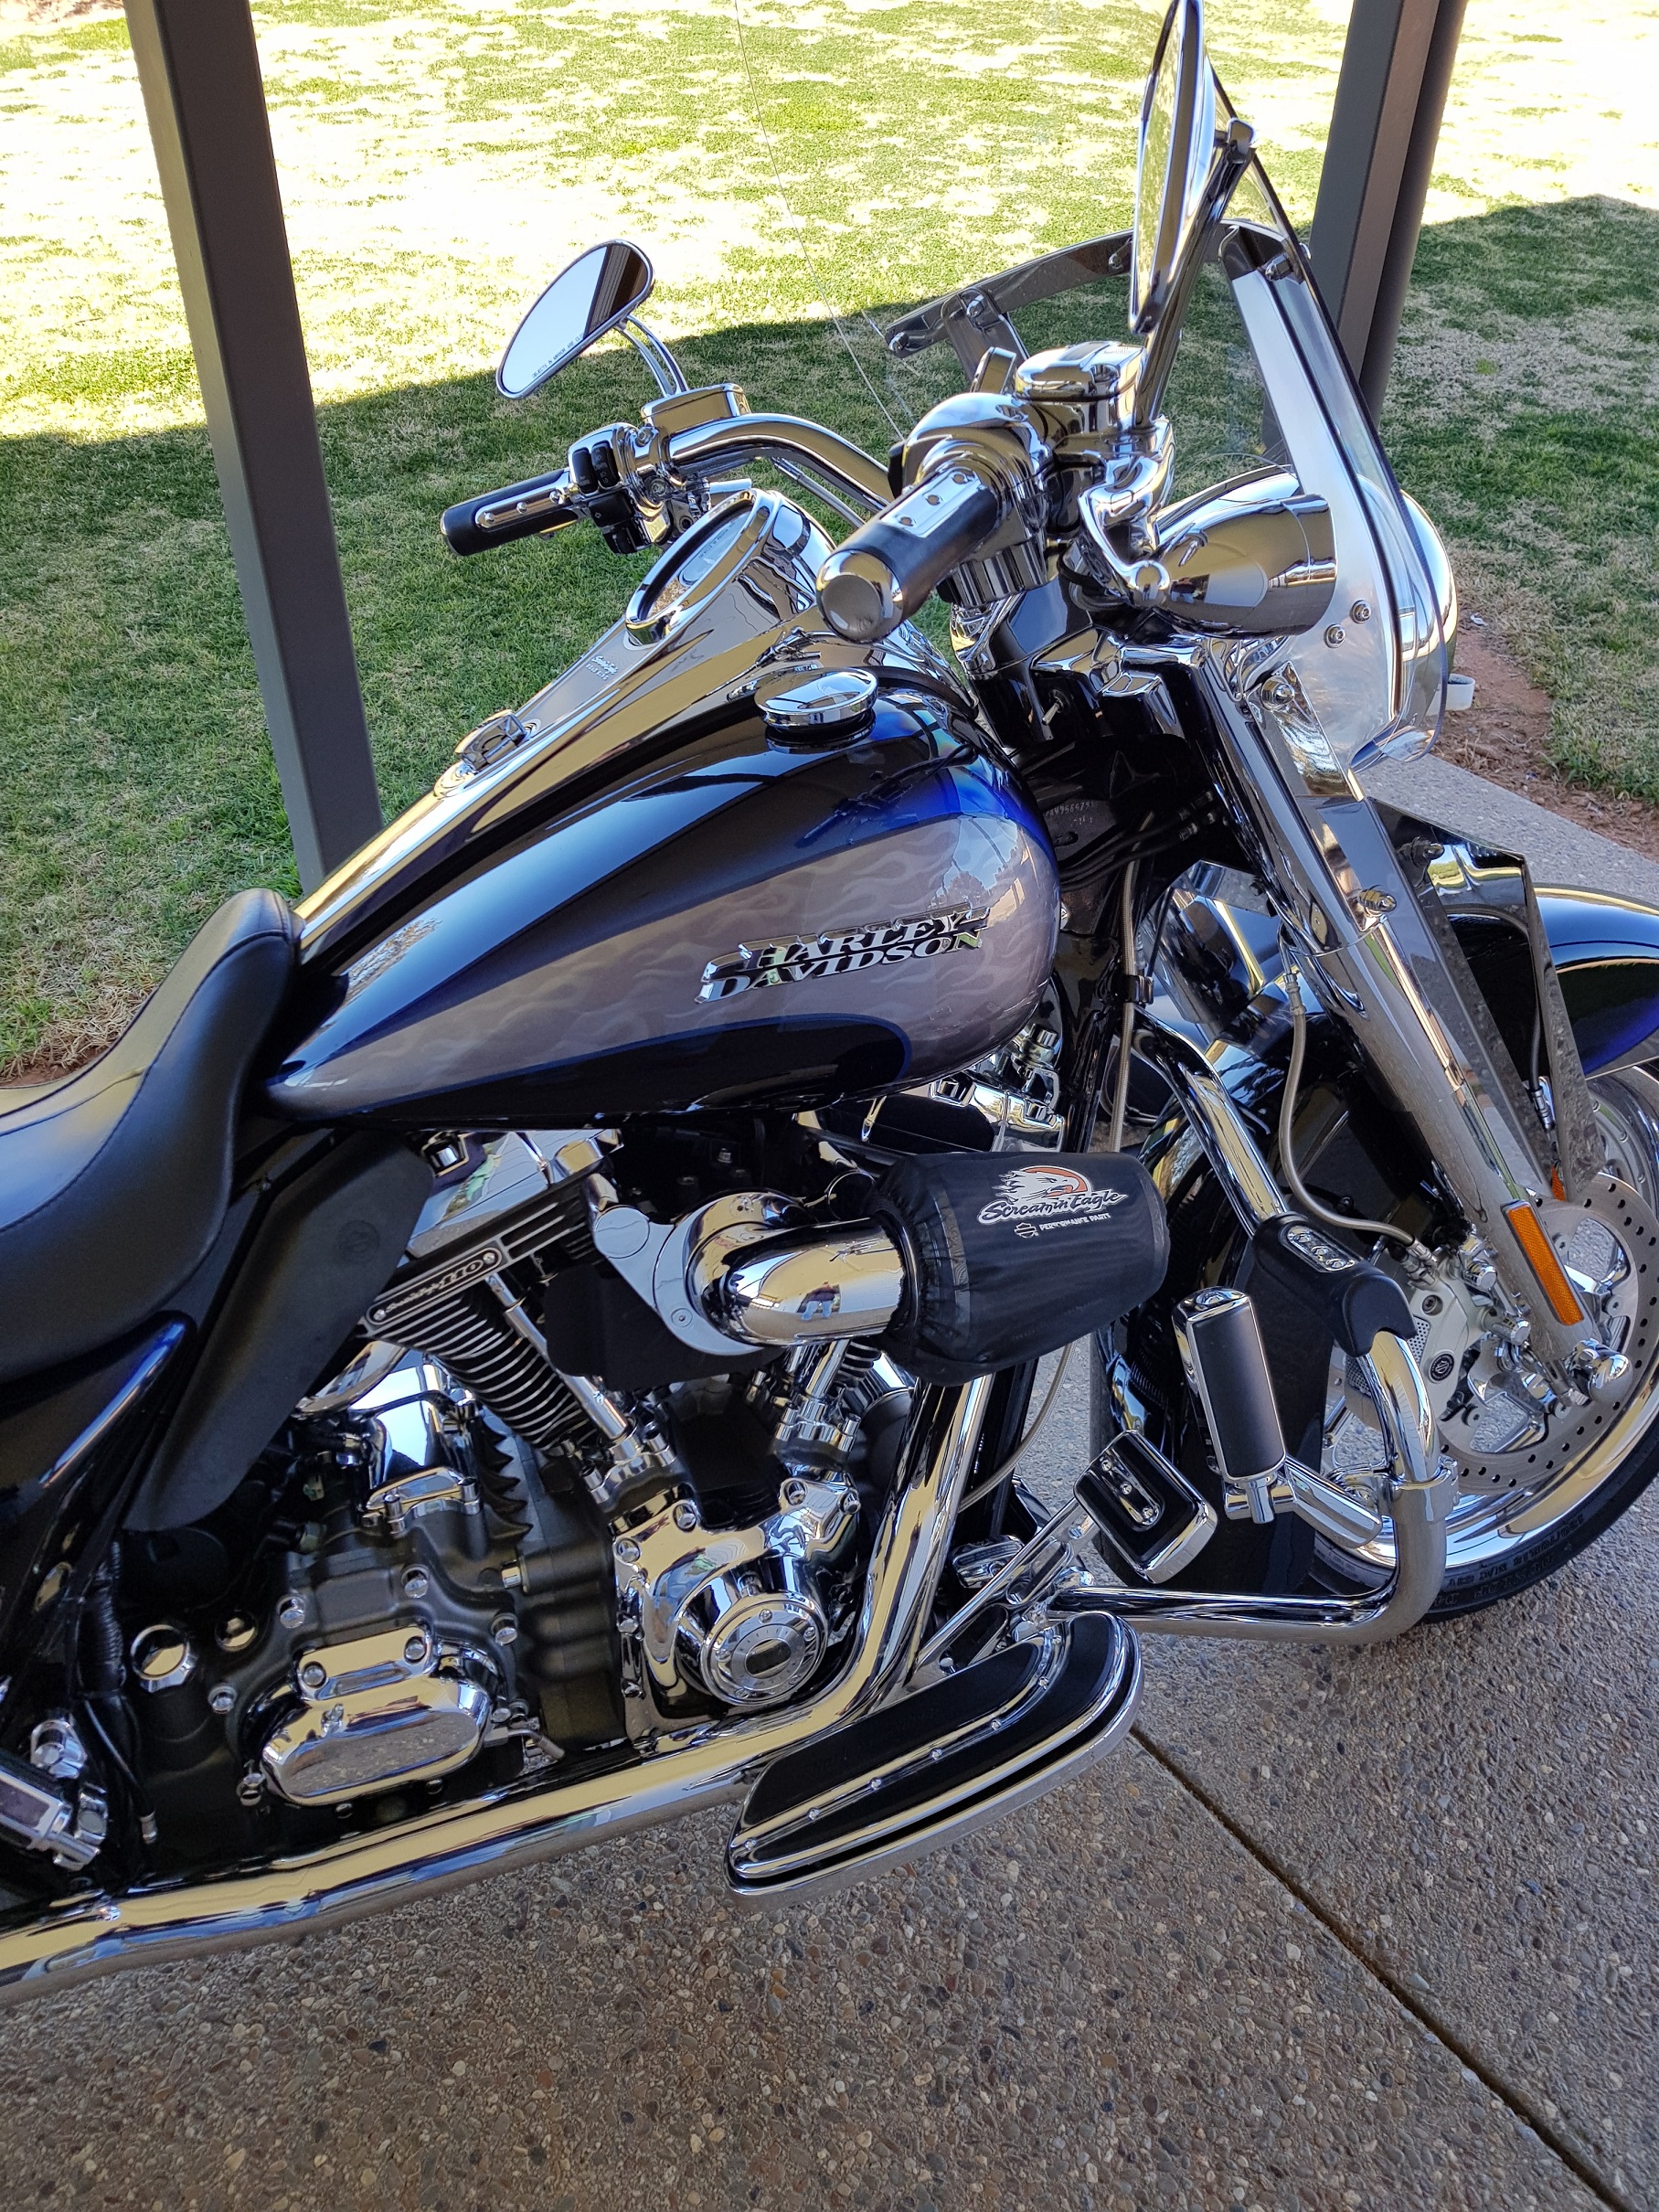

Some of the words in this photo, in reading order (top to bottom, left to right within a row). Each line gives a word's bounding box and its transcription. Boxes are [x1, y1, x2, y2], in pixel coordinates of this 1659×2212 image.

[695, 927, 989, 1004] DAVIDSON
[739, 902, 991, 971] HARLEY
[1070, 1189, 1122, 1212] Eagle
